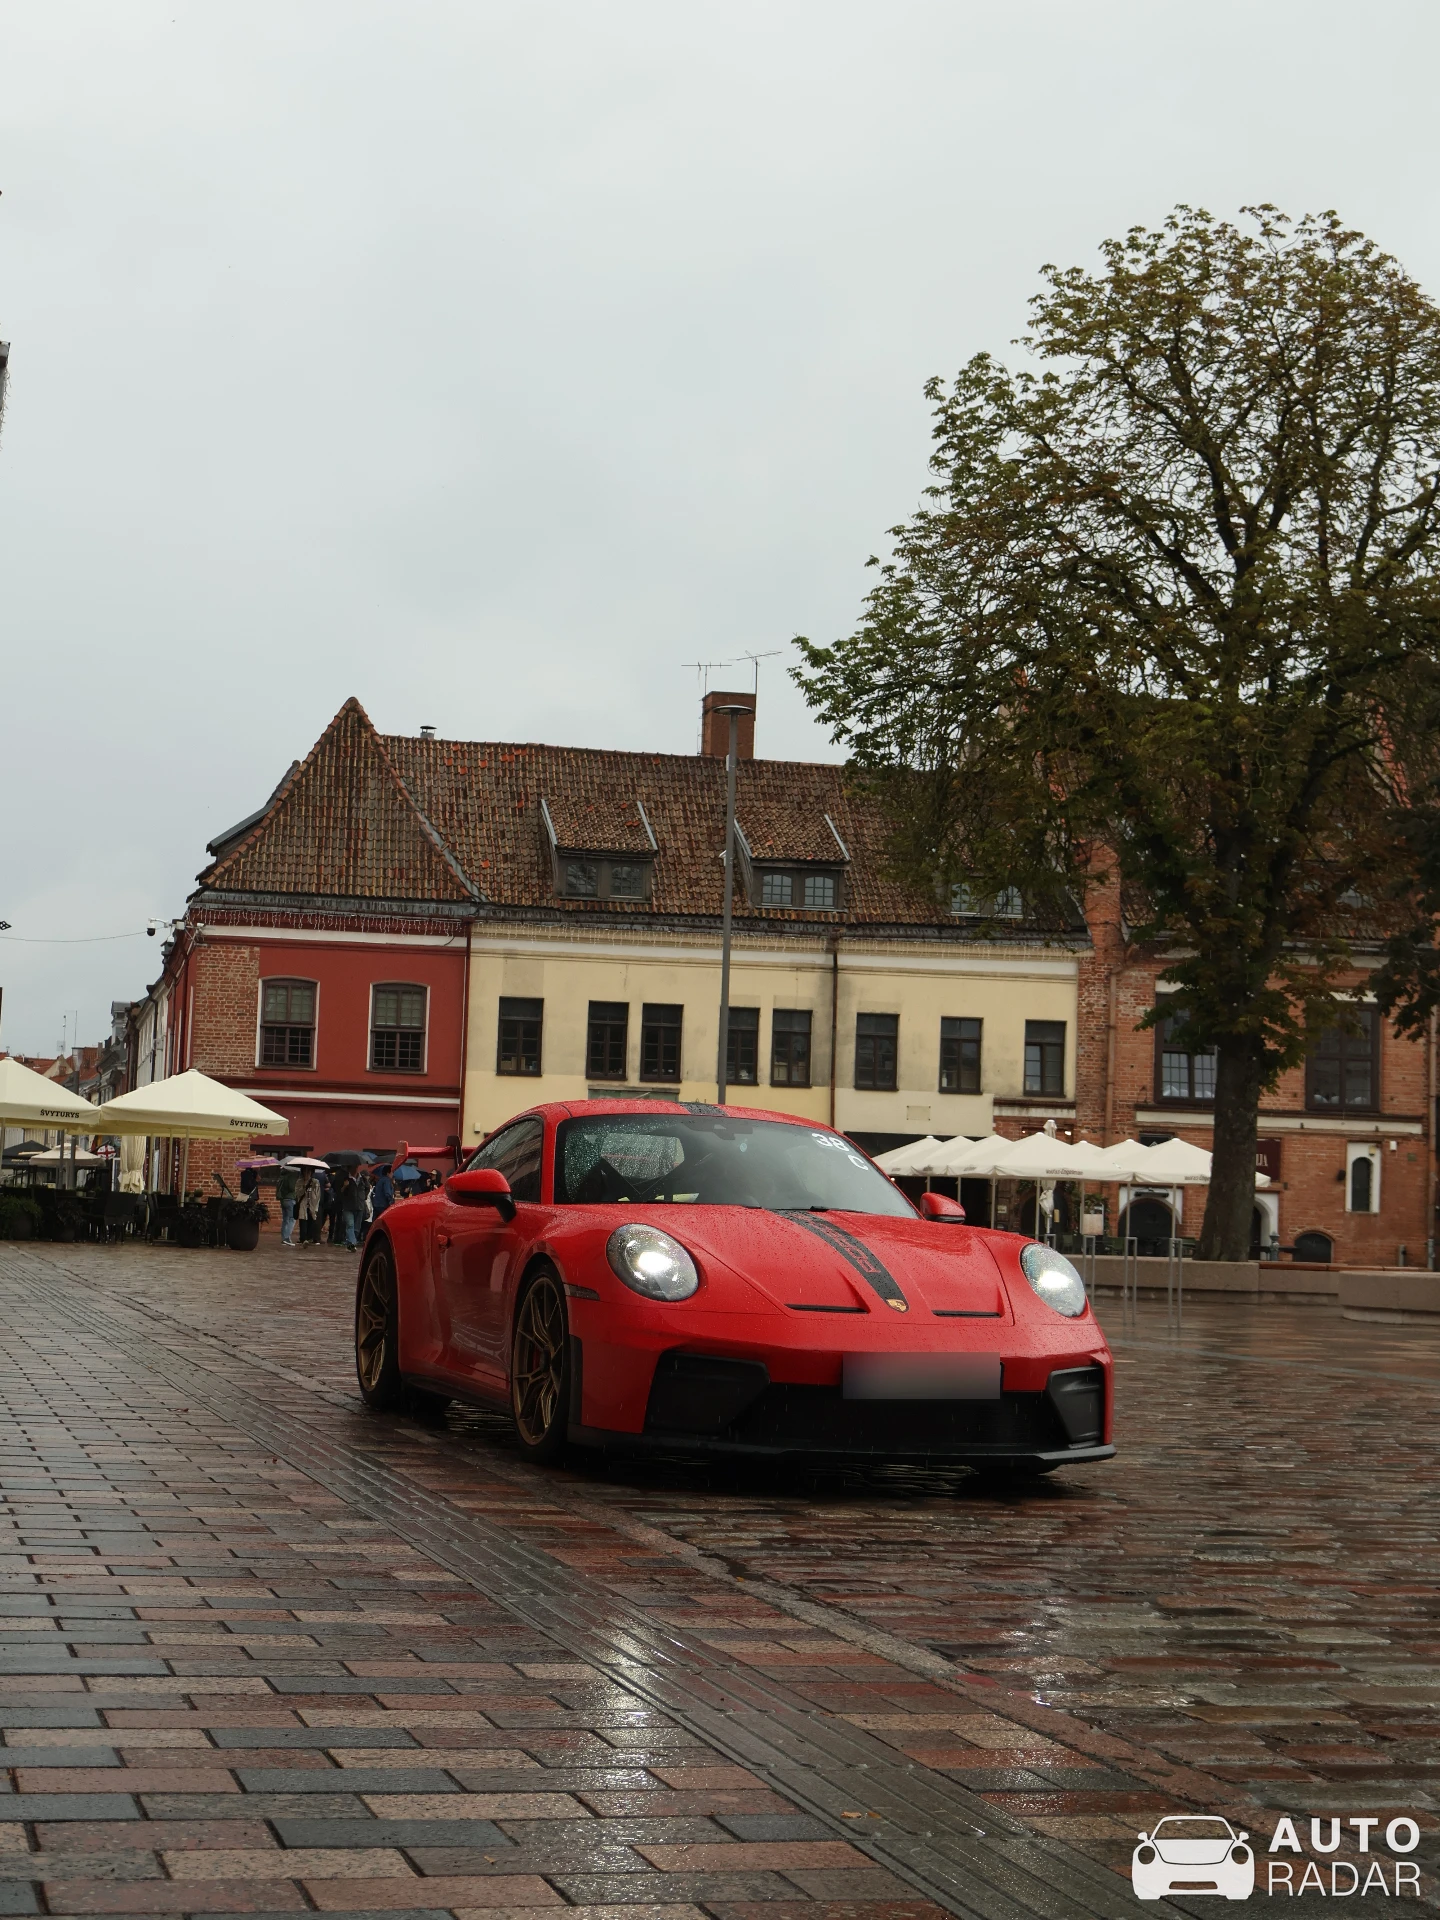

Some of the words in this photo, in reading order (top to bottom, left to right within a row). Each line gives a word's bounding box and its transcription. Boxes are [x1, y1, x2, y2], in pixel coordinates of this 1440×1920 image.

[39, 1109, 80, 1119] ŠVYTURYS
[229, 1118, 268, 1130] ŠVYTURYS
[812, 1133, 849, 1151] 38
[848, 1154, 868, 1170] C
